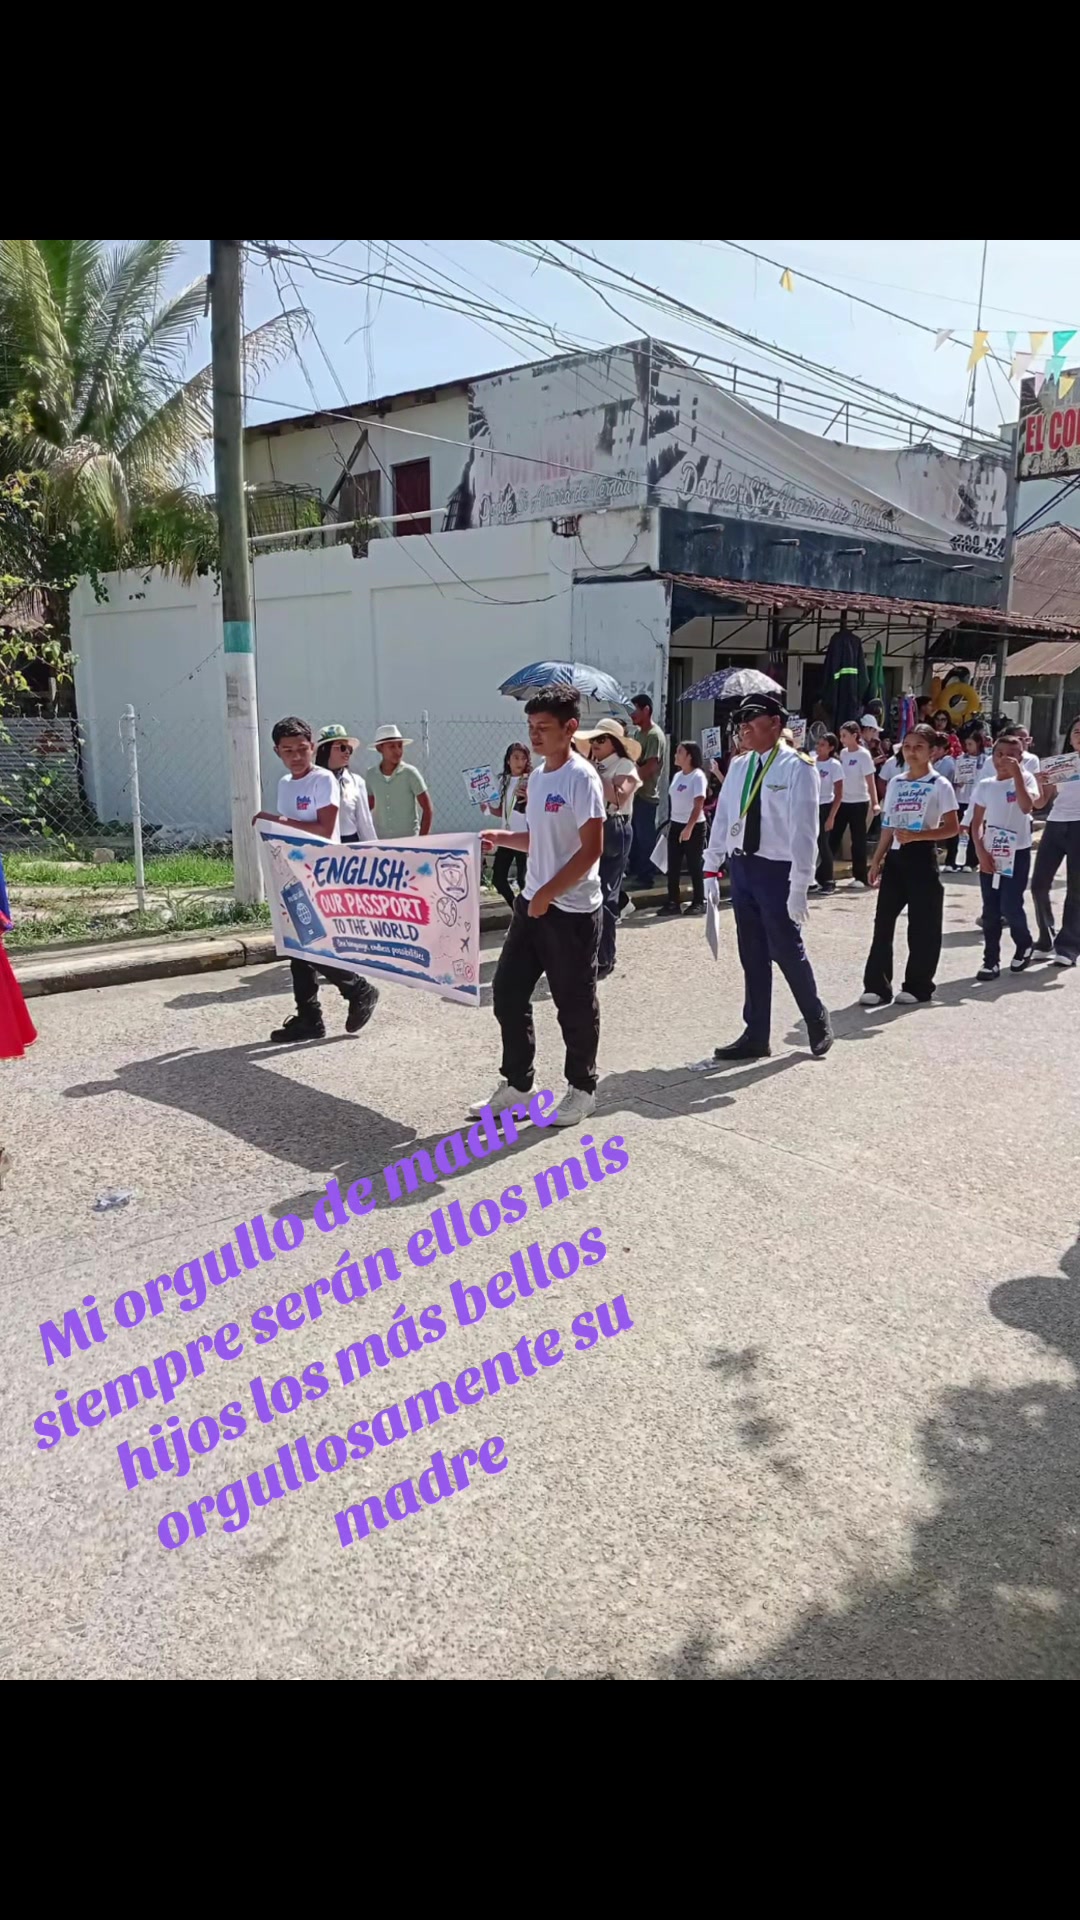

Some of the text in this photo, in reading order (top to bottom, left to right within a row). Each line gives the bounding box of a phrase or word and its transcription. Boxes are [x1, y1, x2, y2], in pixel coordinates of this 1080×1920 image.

[1026, 408, 1080, 453] EL CO
[680, 461, 737, 502] Donde
[619, 681, 655, 694] -524
[313, 856, 410, 891] ENGLISH:
[320, 893, 346, 914] OUR
[345, 893, 423, 920] PASSPORT
[333, 919, 420, 942] TO THE WORLD
